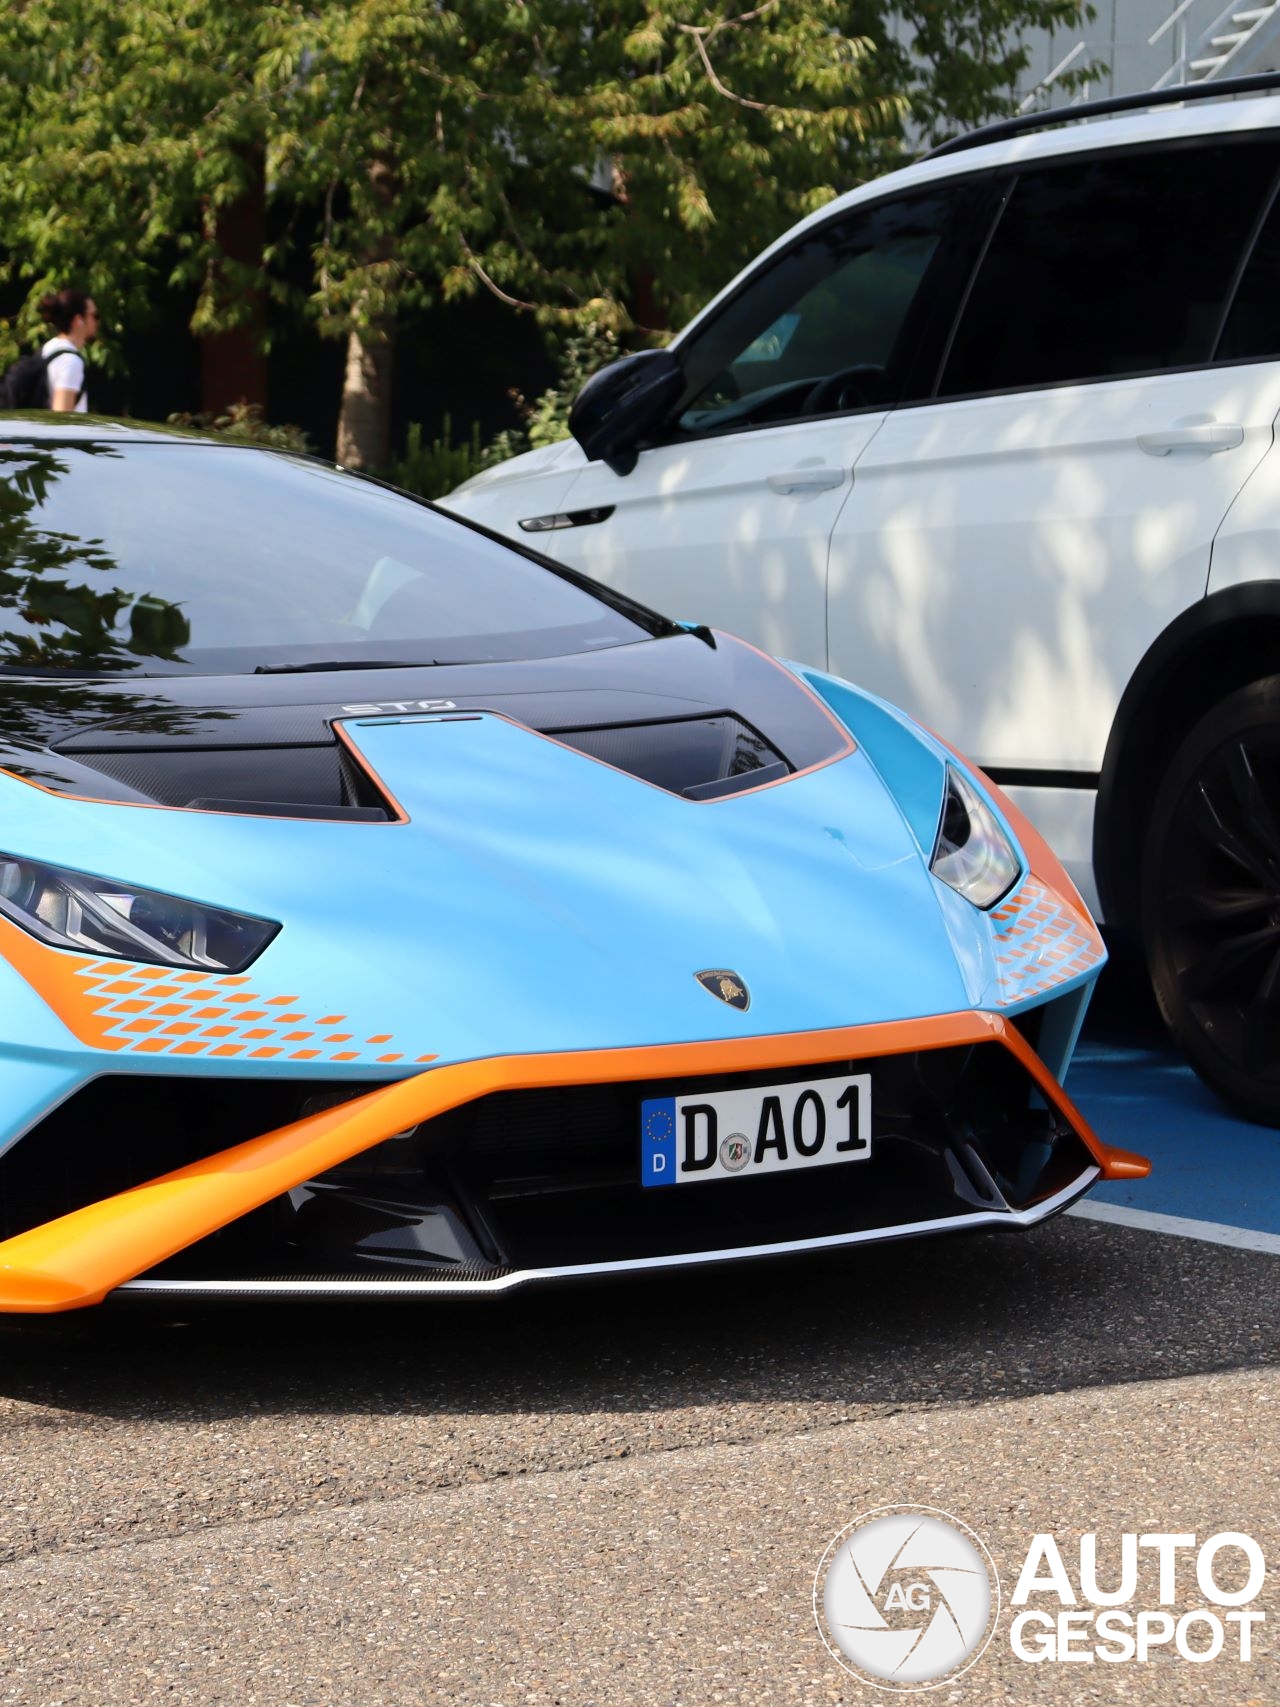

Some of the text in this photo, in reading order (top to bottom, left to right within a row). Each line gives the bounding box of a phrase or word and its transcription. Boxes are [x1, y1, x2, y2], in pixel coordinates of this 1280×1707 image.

[341, 700, 457, 714] STO
[681, 1103, 718, 1172] D
[653, 1154, 666, 1173] D
